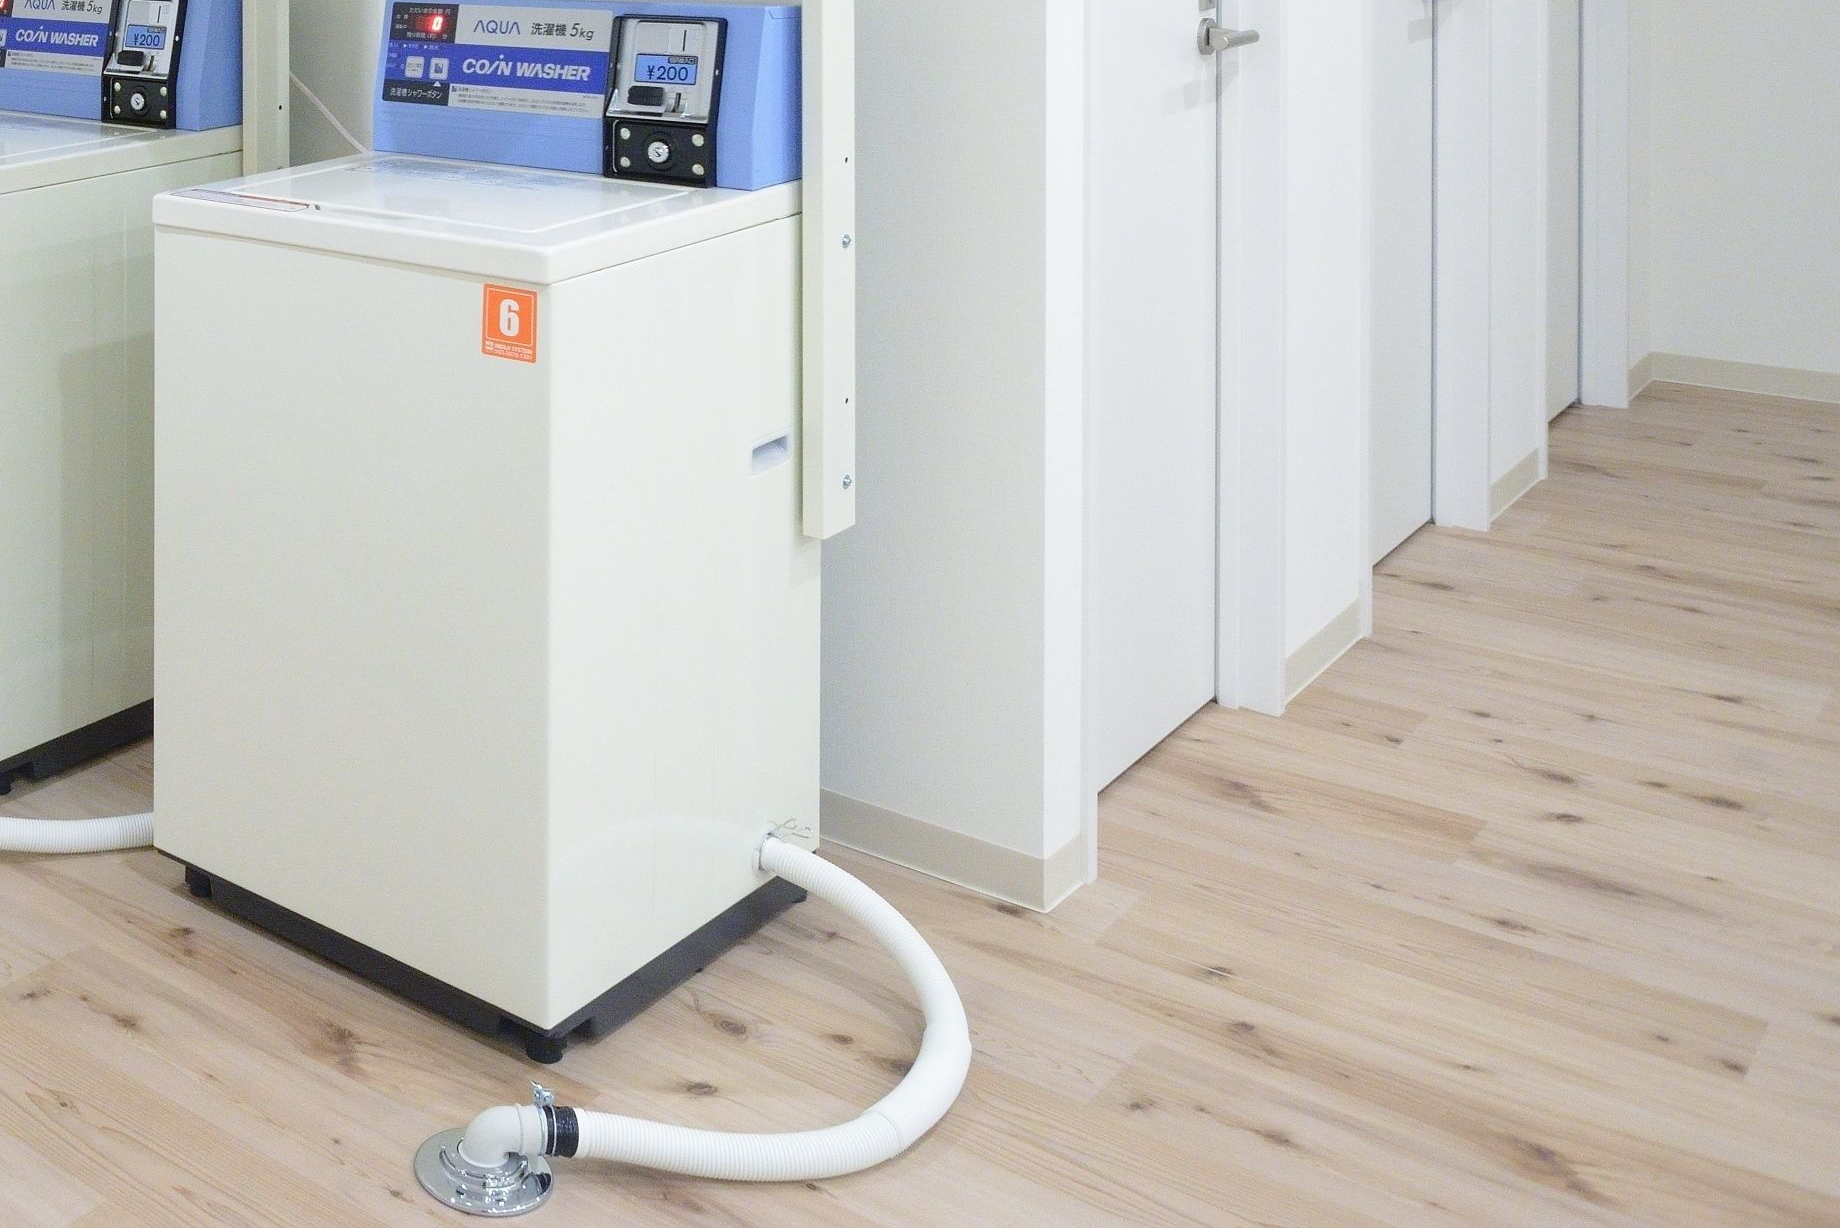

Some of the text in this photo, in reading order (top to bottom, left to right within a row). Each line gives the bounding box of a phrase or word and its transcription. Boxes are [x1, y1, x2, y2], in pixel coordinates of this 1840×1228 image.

[61, 0, 103, 15] 洗濯機 5kg
[431, 16, 443, 31] 0
[473, 19, 521, 35] AQUA
[530, 22, 594, 41] 洗濯機 5kg
[15, 25, 99, 47] COIN WASHER
[133, 34, 160, 47] ¥200
[462, 54, 591, 81] COIN WASHER
[646, 64, 689, 82] ¥200
[499, 298, 520, 337] 6
